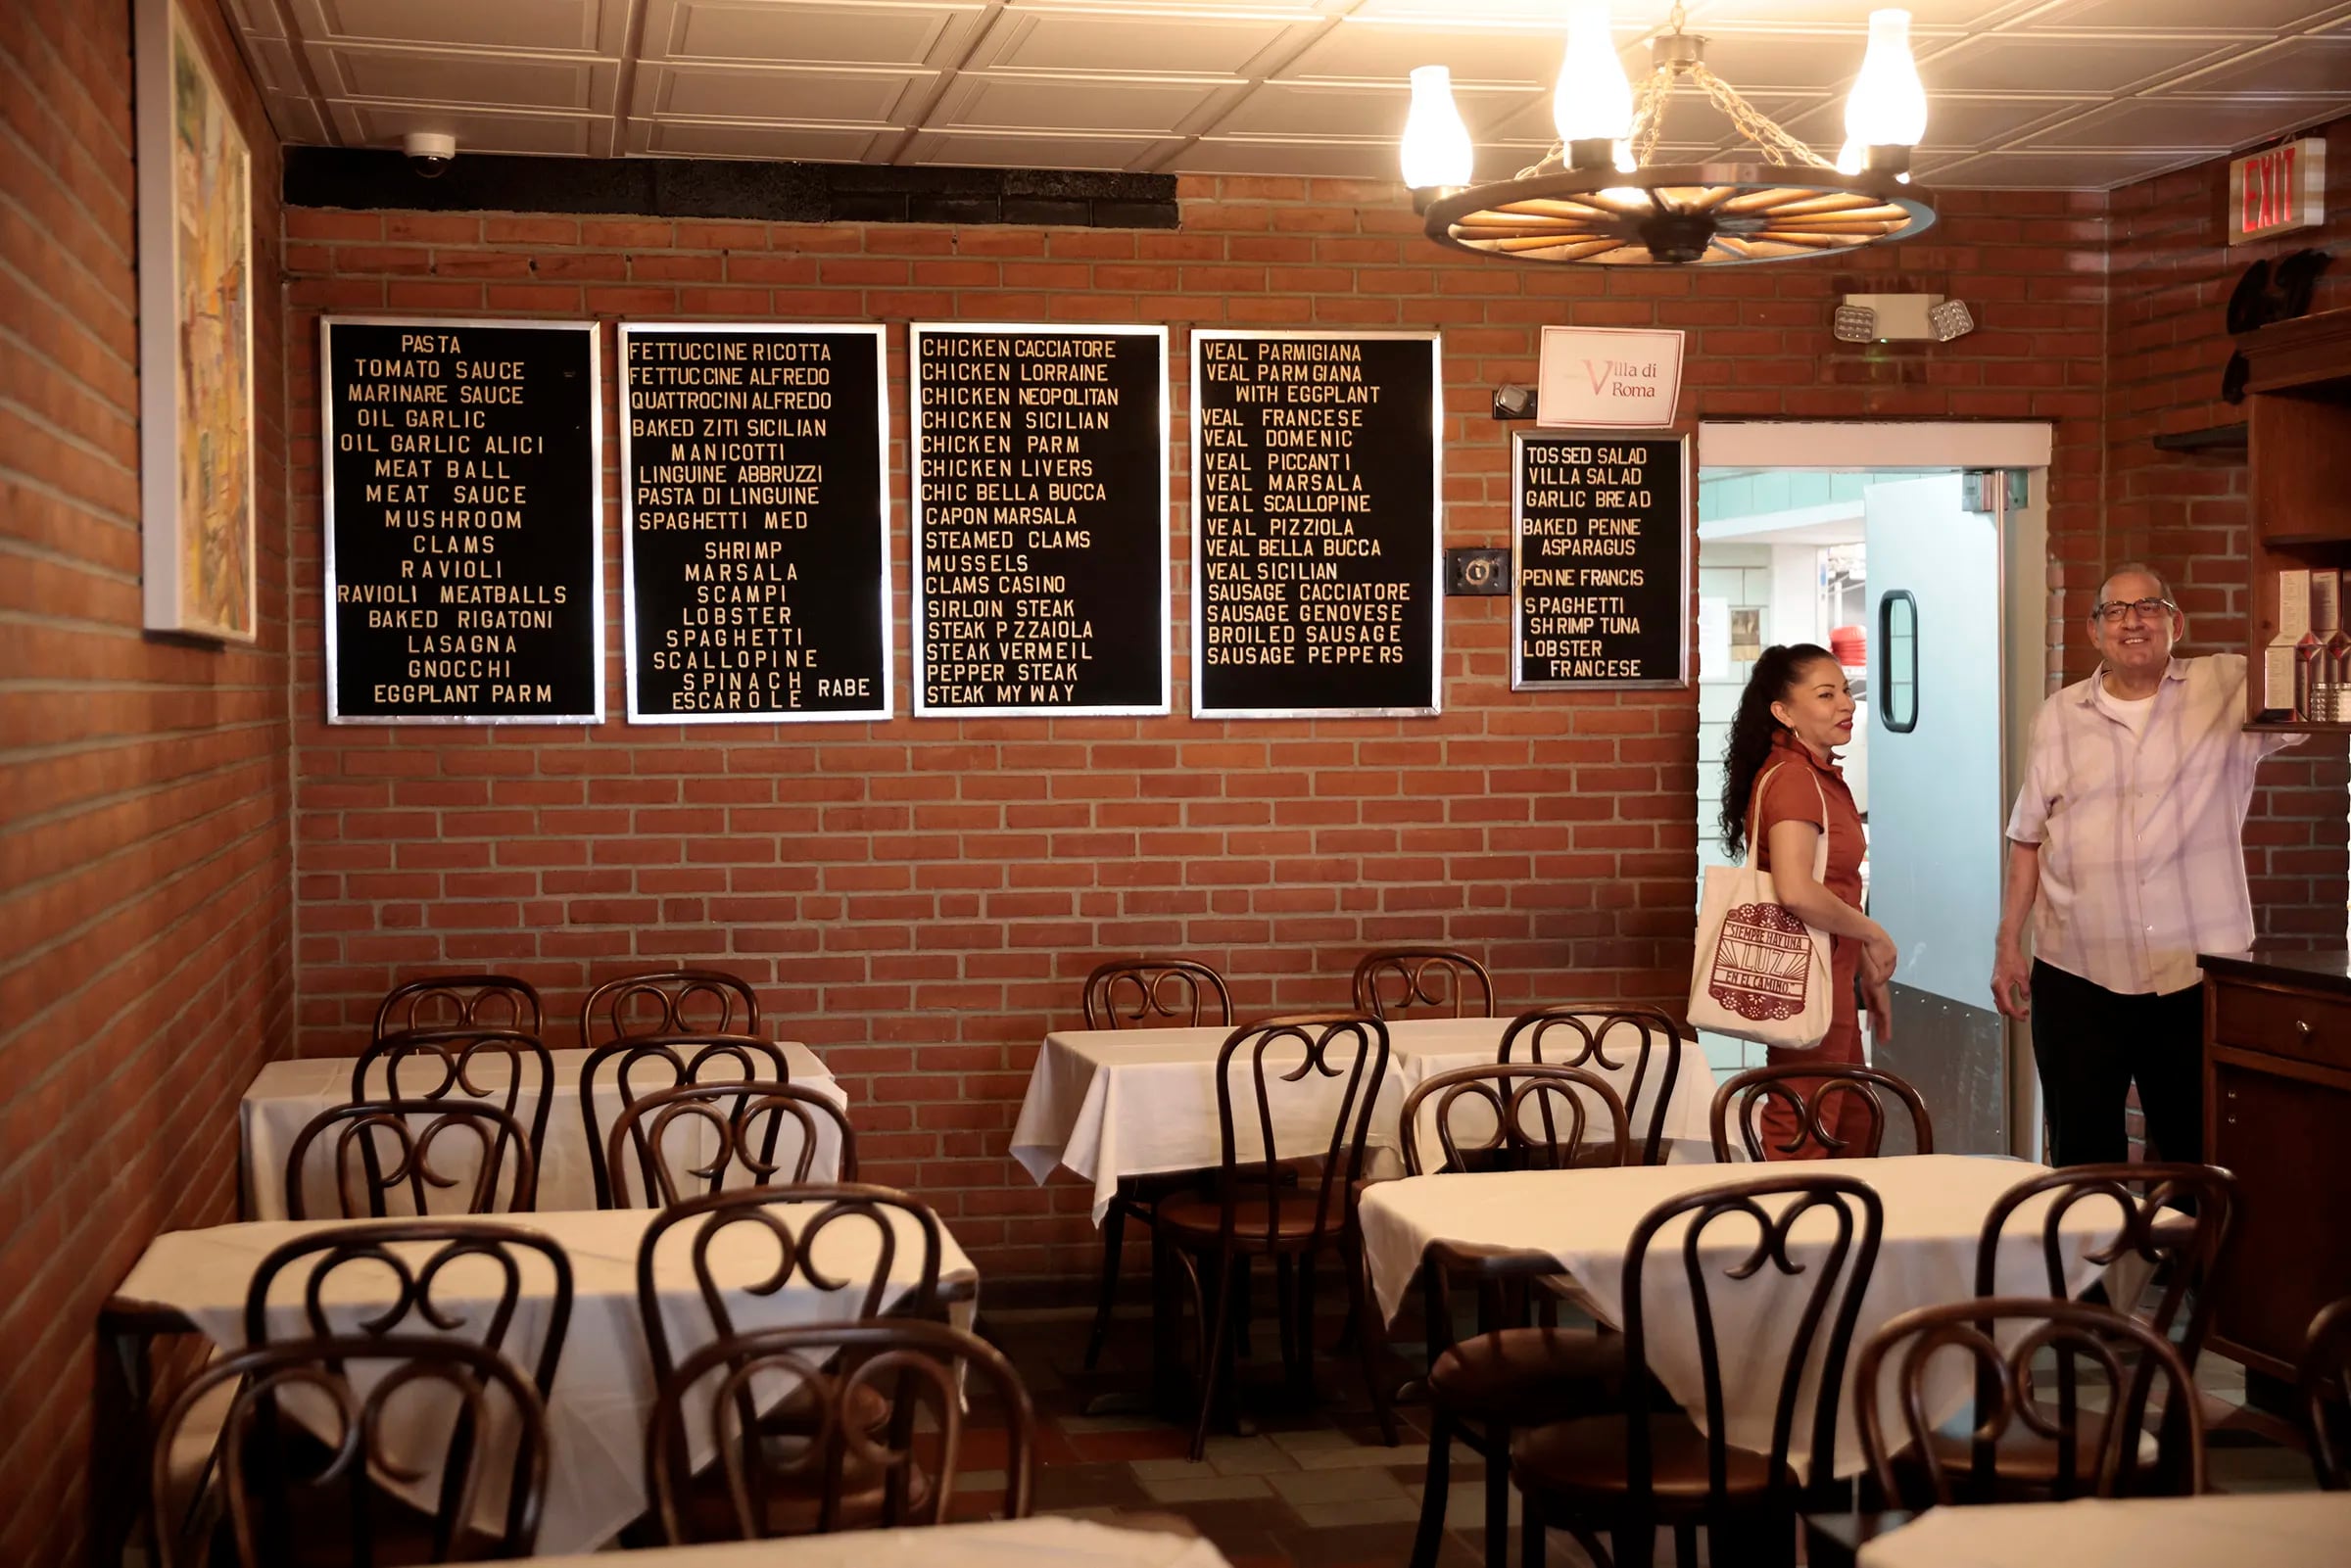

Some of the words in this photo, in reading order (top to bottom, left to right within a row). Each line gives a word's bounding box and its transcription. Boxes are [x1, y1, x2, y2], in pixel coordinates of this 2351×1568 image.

[2242, 147, 2295, 233] EXIT
[402, 335, 460, 354] PASTA
[629, 343, 746, 361] FETTUCCINE
[753, 344, 831, 361] RICOTTA
[923, 339, 1009, 357] CHICKEN
[1015, 340, 1116, 357] CACCIATORE
[1205, 343, 1248, 361] VEAL
[1259, 344, 1361, 361] PARMIGIANA
[356, 359, 440, 378] TOMATO
[456, 361, 524, 380] SAUCE
[630, 367, 743, 386] FETTUCCINE
[749, 367, 830, 385] ALFREDO
[923, 363, 1010, 381] CHICKEN
[1021, 364, 1108, 382] LORRAINE
[1207, 364, 1249, 381] VEAL
[1583, 358, 1637, 396] Villa
[1642, 363, 1656, 377] di
[349, 384, 448, 403] MARINARE
[460, 386, 523, 404] SAUCE
[923, 388, 1010, 405] CHICKEN
[1019, 388, 1118, 405] NEOPOLITAN
[1236, 386, 1277, 403] WITH
[1288, 386, 1380, 404] EGGPLANT
[1612, 382, 1655, 398] Roma
[632, 392, 746, 409] QUATTROCINI
[752, 392, 831, 409] ALFREDO
[358, 409, 394, 427] OIL
[406, 410, 485, 428] GARLIC
[922, 411, 1011, 429] CHICKEN
[1026, 411, 1109, 429] SICILIAN
[1202, 408, 1243, 426] VEAL
[1263, 409, 1363, 427] FRANCESE
[633, 419, 694, 437] BAKED
[703, 419, 739, 437] ZITI
[747, 419, 826, 437] SICILIAN
[341, 434, 379, 451] OIL
[391, 435, 470, 452] GARLIC
[485, 436, 543, 454] ALICI
[922, 436, 1011, 452] CHICKEN
[1028, 436, 1080, 453] PARM
[1204, 430, 1248, 448] VEAL
[1266, 430, 1352, 448] DOMENIC
[671, 444, 784, 461] MANICOTTI
[1205, 453, 1251, 470] VEAL
[1269, 453, 1351, 470] PICCANTI
[1527, 448, 1592, 464] TOSSED
[1597, 448, 1647, 464] SALAD
[375, 459, 432, 477] MEAT
[448, 461, 510, 479] BALL
[641, 465, 726, 483] LINGUINE
[738, 465, 822, 483] ABBRUZZI
[922, 459, 1011, 477] CHICKEN
[1022, 459, 1092, 477] LIVERS
[1529, 468, 1580, 485] VILLA
[1587, 468, 1642, 485] SALAD
[1206, 474, 1252, 492] VEAL
[1269, 474, 1362, 492] MARSALA
[366, 485, 429, 501] MEAT
[454, 486, 526, 503] SAUCE
[638, 488, 695, 504] PASTA
[703, 488, 721, 504] DI
[731, 487, 819, 504] LINGUINE
[922, 484, 967, 501] CHIC
[977, 484, 1038, 500] BELLA
[1049, 484, 1106, 500] BUCCA
[1526, 491, 1586, 507] GARLIC
[1596, 491, 1651, 507] BREAD
[1207, 496, 1253, 512] VEAL
[1264, 495, 1370, 513] SCALLOPINE
[386, 510, 521, 529] MUSHROOM
[640, 511, 746, 530] SPAGHETTI
[764, 511, 808, 529] MED
[926, 507, 987, 525] CAPON
[993, 507, 1077, 525] MARSALA
[1207, 519, 1256, 536] VEAL
[1271, 519, 1354, 536] PIZZIOLA
[1523, 518, 1577, 536] BAKED
[1588, 519, 1641, 536] PENNE
[413, 536, 495, 553] CLAMS
[926, 531, 1013, 548] STEAMED
[1029, 531, 1090, 548] CLAMS
[1206, 540, 1250, 556] VEAL
[1259, 540, 1314, 556] BELLA
[1323, 540, 1380, 556] BUCCA
[1542, 539, 1635, 556] ASPARAGUS
[705, 542, 783, 560] SHRIMP
[402, 560, 502, 578] RAVIOLI
[927, 554, 1028, 573] MUSSELS
[1207, 563, 1251, 580] VEAL
[1258, 563, 1337, 580] SICILIAN
[685, 564, 797, 582] MARSALA
[1522, 570, 1575, 586] PENNE
[1580, 569, 1644, 587] FRANCIS
[338, 585, 416, 603] RAVIOLI
[441, 586, 566, 603] MEATBALLS
[926, 576, 989, 594] CLAMS
[999, 576, 1065, 594] CASINO
[1209, 584, 1285, 601] SAUSAGE
[1300, 584, 1410, 601] CACCIATORE
[697, 586, 786, 603] SCAMPI
[928, 599, 1003, 618] SIRLOIN
[1017, 599, 1074, 617] STEAK
[1207, 605, 1289, 623] SAUSAGE
[1300, 604, 1403, 622] GENOVESE
[1525, 597, 1623, 614] SPAGHETTI
[369, 610, 438, 628] BAKED
[458, 611, 552, 629] RIGATONI
[684, 607, 792, 625] LOBSTER
[928, 622, 984, 640] STEAK
[1209, 626, 1295, 643] BROILED
[1306, 625, 1401, 642] SAUSAGE
[1530, 618, 1594, 635] SHRIMP
[1600, 617, 1640, 634] TUNA
[408, 636, 516, 653] LASAGNA
[666, 628, 802, 647] SPAGHETTI
[927, 642, 989, 661] STEAK
[999, 642, 1092, 660] VERMEIL
[1207, 647, 1295, 665] SAUSAGE
[1309, 646, 1403, 664] PEPPERS
[1524, 641, 1602, 657] LOBSTER
[653, 650, 817, 669] SCALLOPINE
[1551, 660, 1641, 677] FRANCESE
[408, 660, 510, 678] GNOCCHI
[927, 664, 1004, 682] PEPPER
[1019, 663, 1078, 681] STEAK
[683, 672, 801, 690] SPINACH
[818, 679, 870, 697] RABE
[374, 685, 479, 702] EGGPLANT
[493, 685, 552, 702] PARM
[673, 690, 801, 710] ESCAROLE
[927, 686, 984, 703] STEAK
[997, 685, 1022, 703] MY
[1031, 685, 1074, 702] WAY
[1767, 932, 1782, 946] HAY
[1784, 936, 1801, 949] UNA
[1743, 944, 1785, 976] LUZ
[1726, 972, 1737, 981] EN
[1742, 975, 1751, 984] EL
